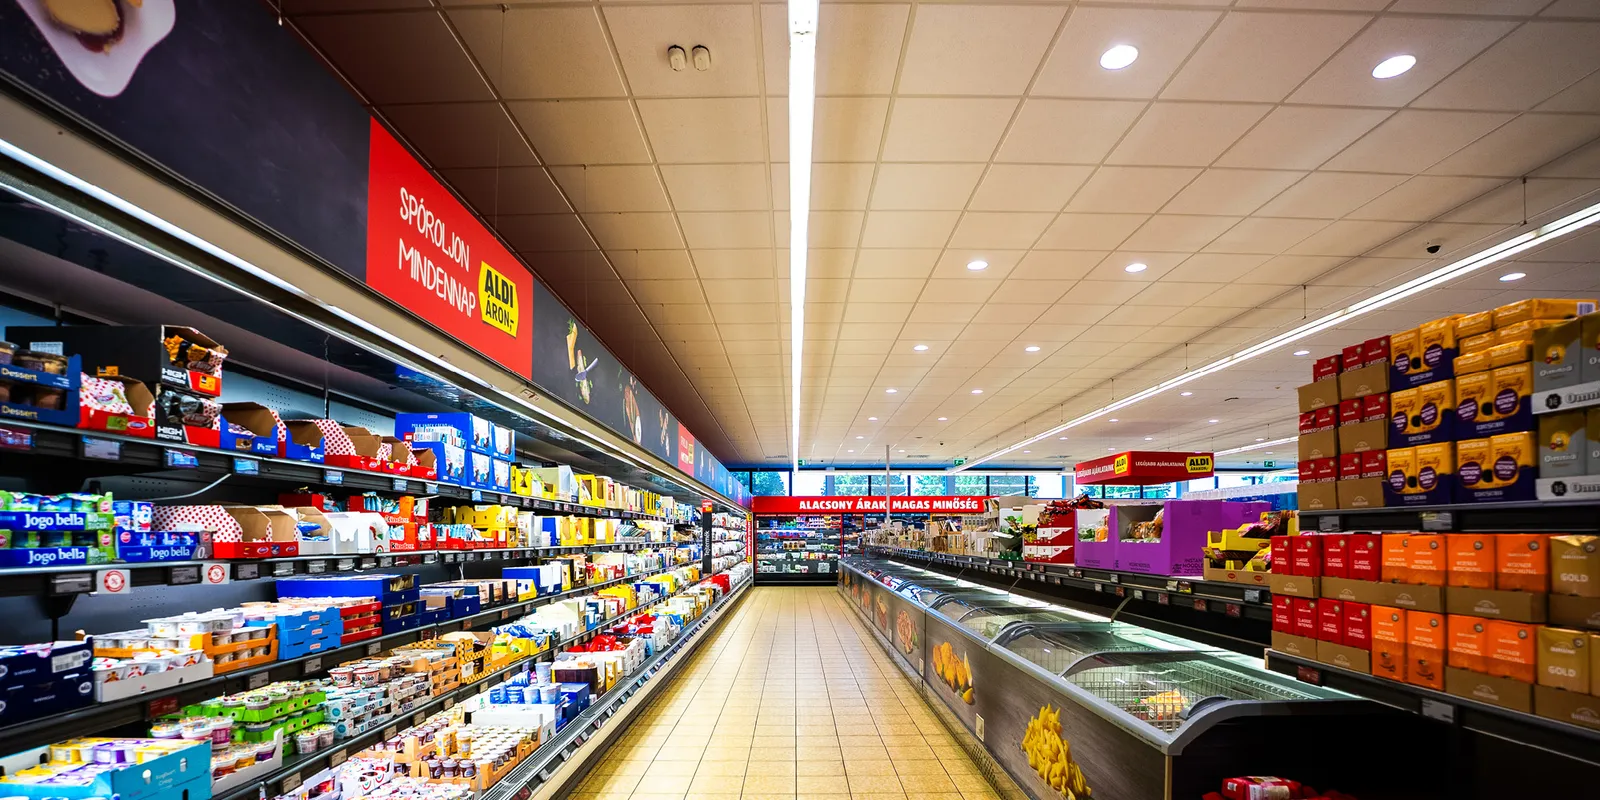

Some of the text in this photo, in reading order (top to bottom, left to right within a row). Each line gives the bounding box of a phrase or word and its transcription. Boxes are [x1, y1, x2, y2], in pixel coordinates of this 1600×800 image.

[400, 187, 470, 272] SPÓROLJON
[399, 238, 476, 317] MINDENNAP
[484, 268, 514, 308] ALDI
[2, 368, 37, 382] Dessert
[162, 368, 186, 380] HIGH
[2, 406, 38, 418] Dessert
[157, 426, 182, 436] HIGH
[1116, 458, 1126, 468] ALDI
[1189, 458, 1209, 466] ALDI
[800, 498, 978, 510] ALACSONY ÁRAK MAGAS MINŐSÉG
[24, 514, 54, 529] Jogo
[56, 514, 84, 526] bella
[27, 548, 85, 564] Jogo bella
[150, 546, 190, 559] Jogo bella
[1560, 573, 1588, 582] GOLD
[1548, 666, 1576, 678] GOLD
